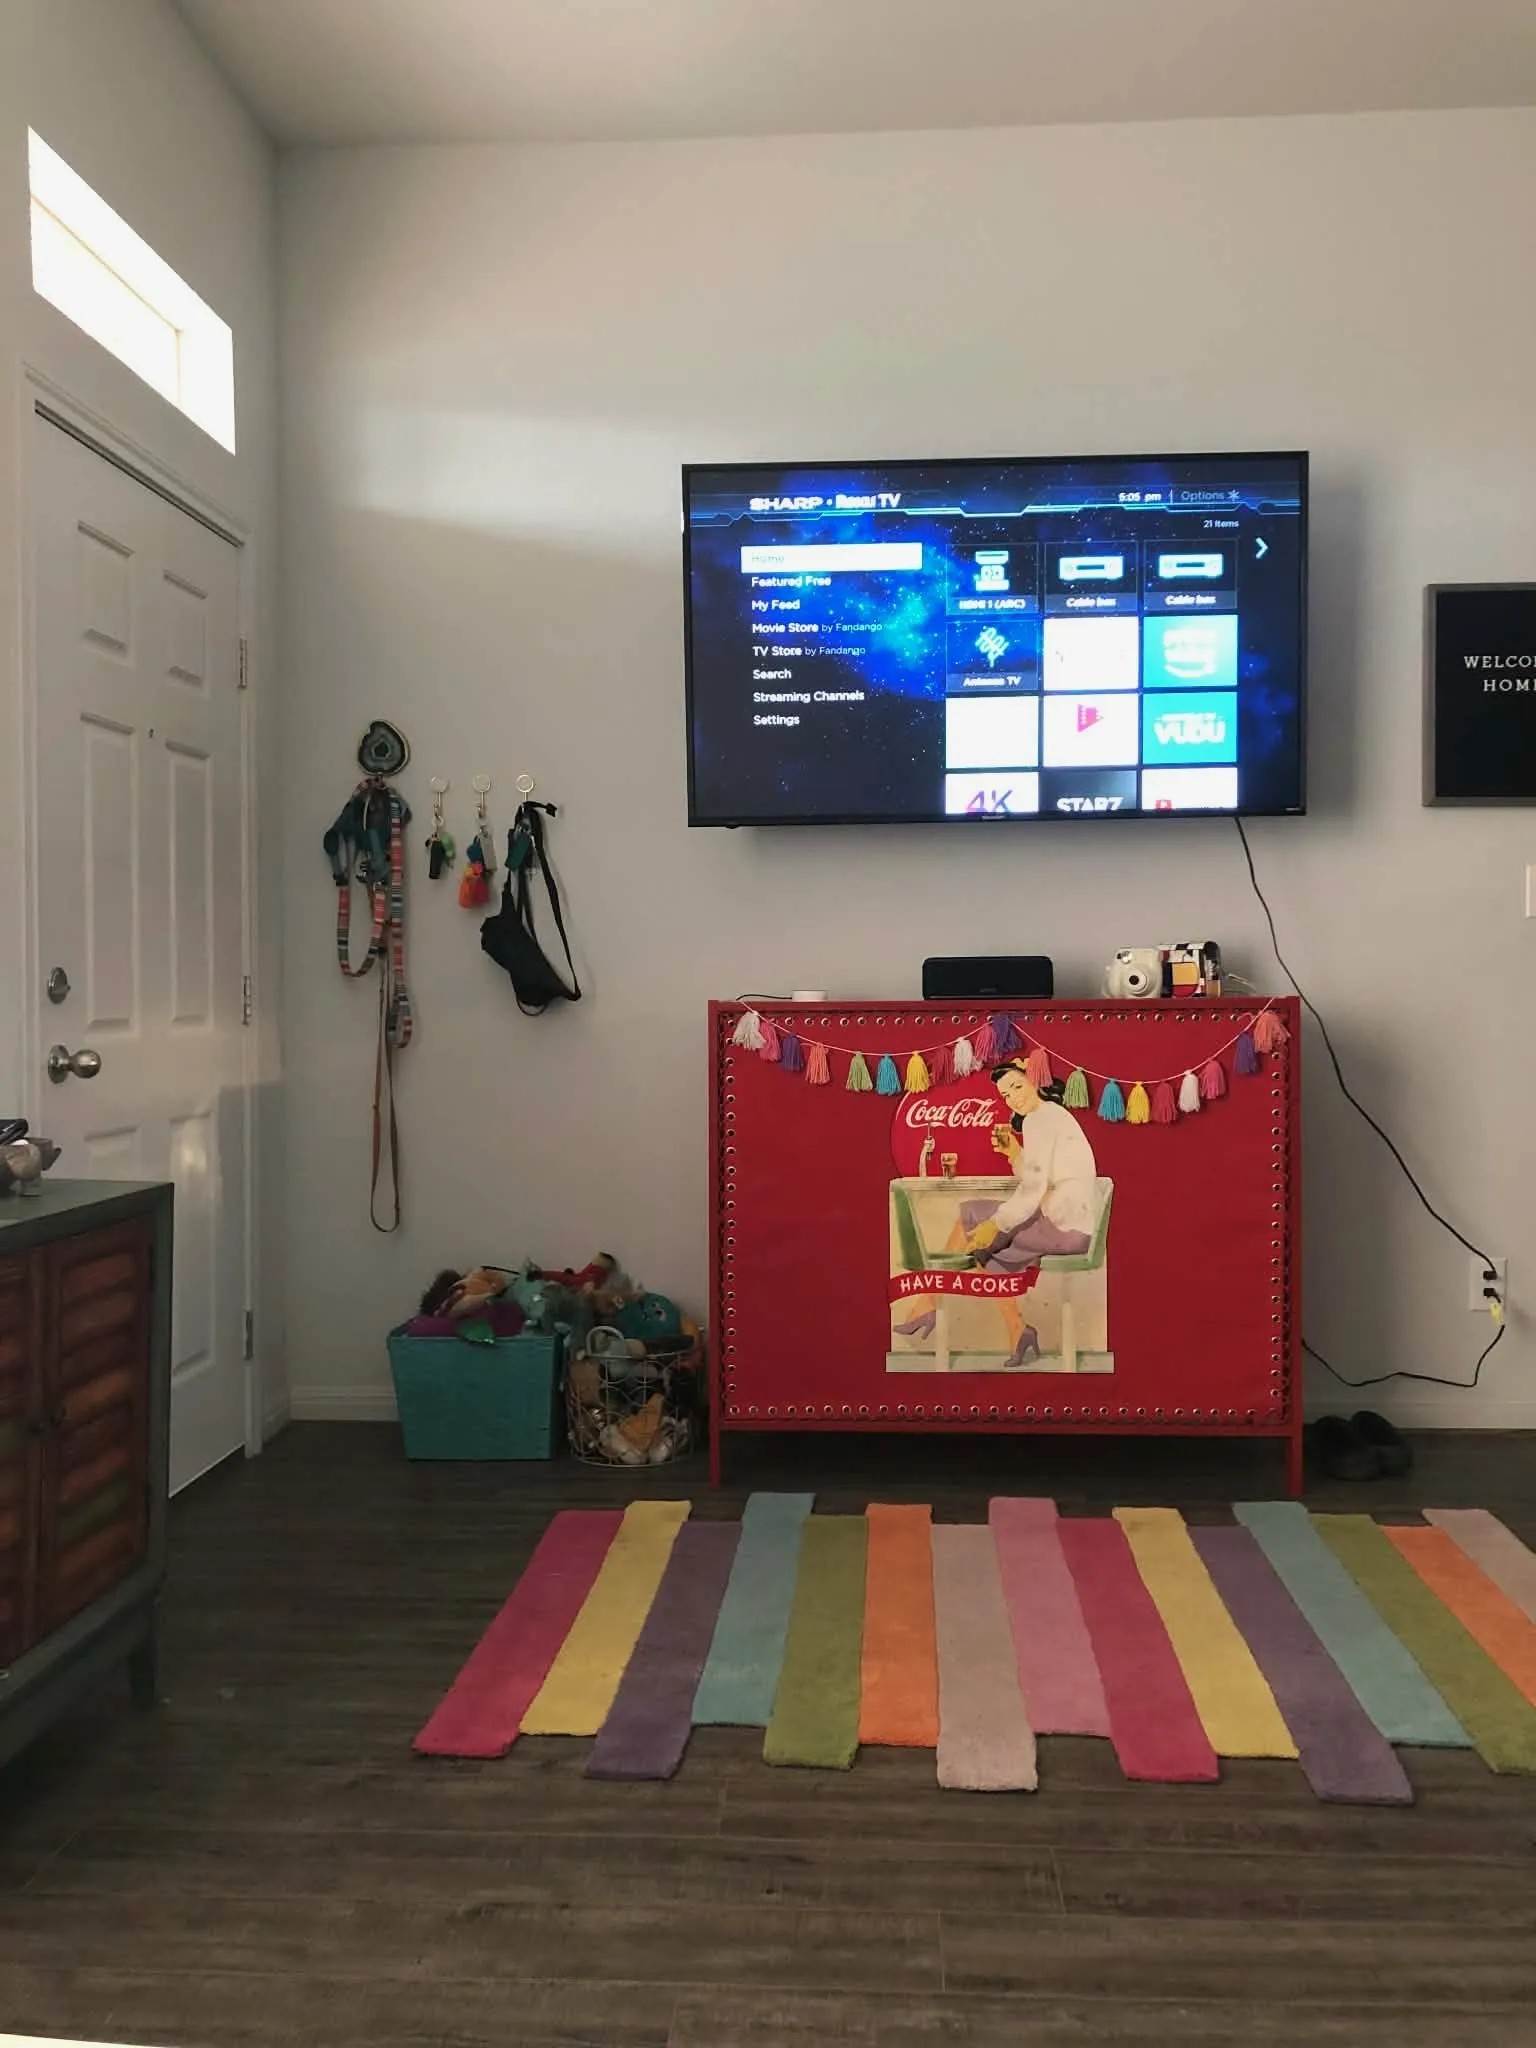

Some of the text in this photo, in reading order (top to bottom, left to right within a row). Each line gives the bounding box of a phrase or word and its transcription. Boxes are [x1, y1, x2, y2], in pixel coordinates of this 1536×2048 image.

[750, 497, 823, 511] SHARP
[877, 493, 901, 508] TV
[1144, 493, 1162, 503] pm
[1180, 490, 1225, 502] Options
[1203, 519, 1213, 529] 21
[751, 575, 832, 589] Featured Free
[751, 598, 801, 613] My Feed
[752, 622, 883, 635] Movie Store by Fandango
[752, 645, 866, 657] TV Store by Fandango
[752, 667, 792, 680] Search
[1007, 675, 1022, 687] TV
[752, 689, 865, 704] Streaming Channels
[753, 713, 800, 727] Settings
[965, 789, 1014, 813] 4K
[899, 1275, 1020, 1293] HAVE A COKE
